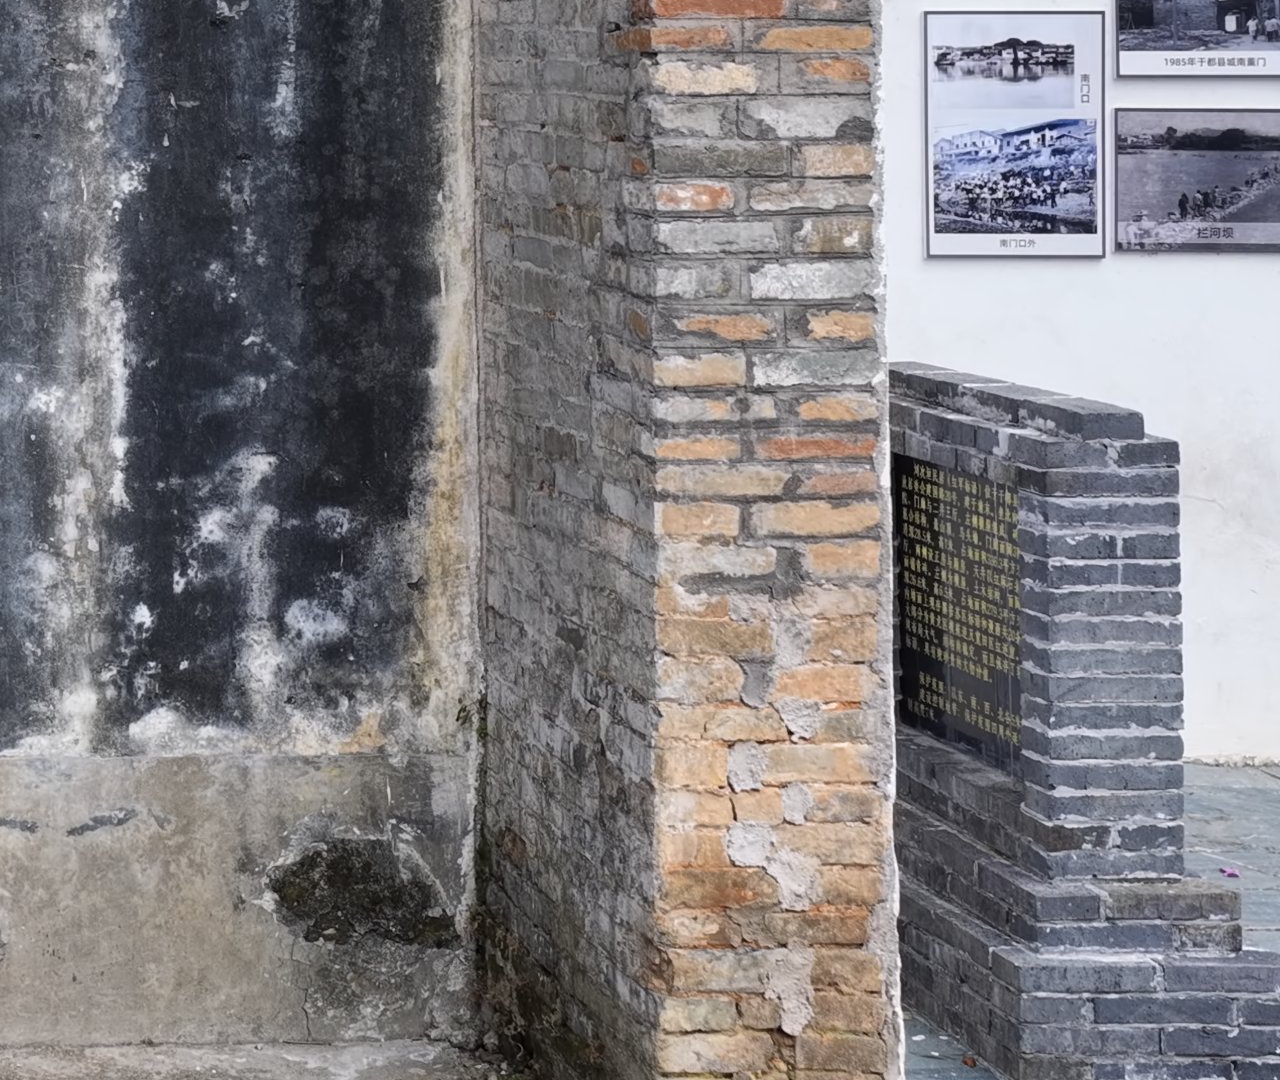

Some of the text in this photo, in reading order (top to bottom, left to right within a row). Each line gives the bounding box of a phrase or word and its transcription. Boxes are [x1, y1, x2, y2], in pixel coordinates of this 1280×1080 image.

[1080, 74, 1090, 103] 南门口
[1197, 227, 1234, 239] 拦河坝
[999, 239, 1037, 248] 南门口外
